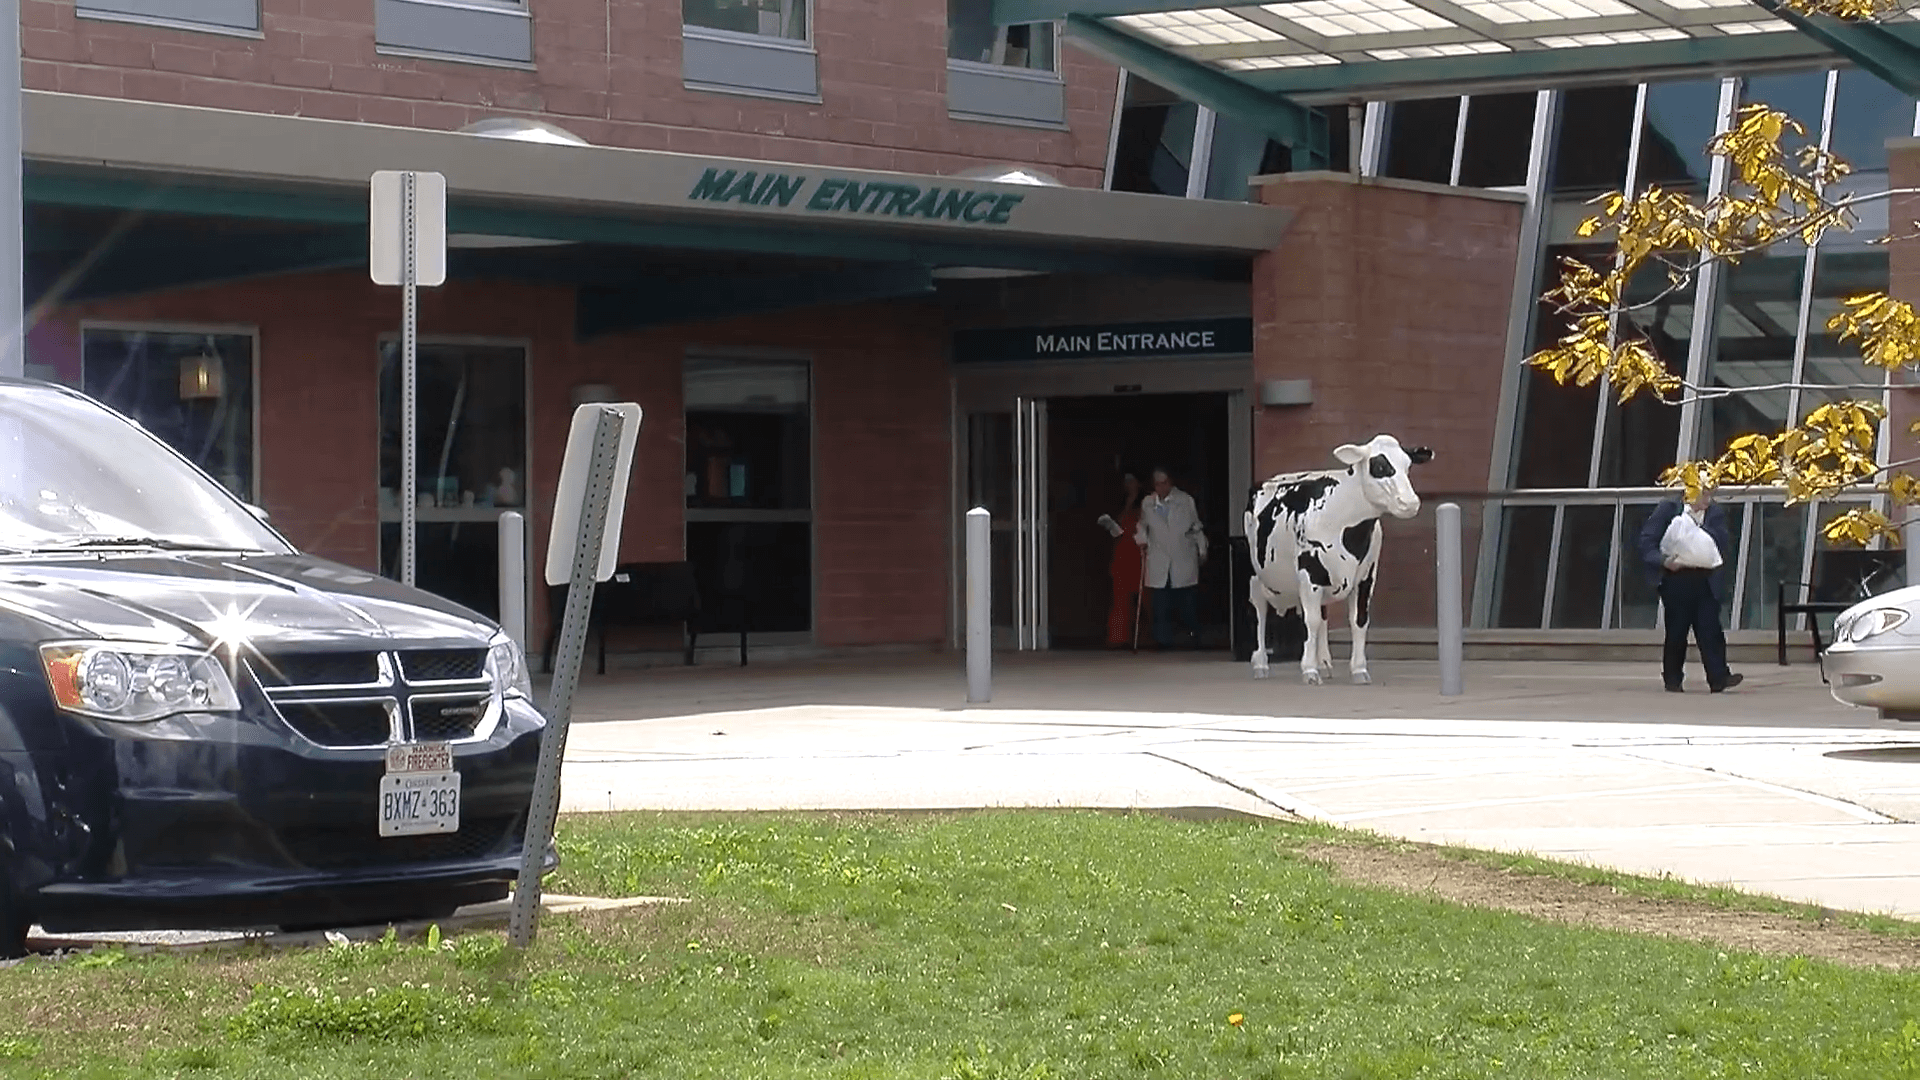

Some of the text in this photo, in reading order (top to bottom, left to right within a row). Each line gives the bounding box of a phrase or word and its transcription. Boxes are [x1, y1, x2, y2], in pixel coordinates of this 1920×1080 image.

[689, 167, 1023, 223] MAIN ENTRANCE
[407, 752, 450, 771] FIREFIGHTER
